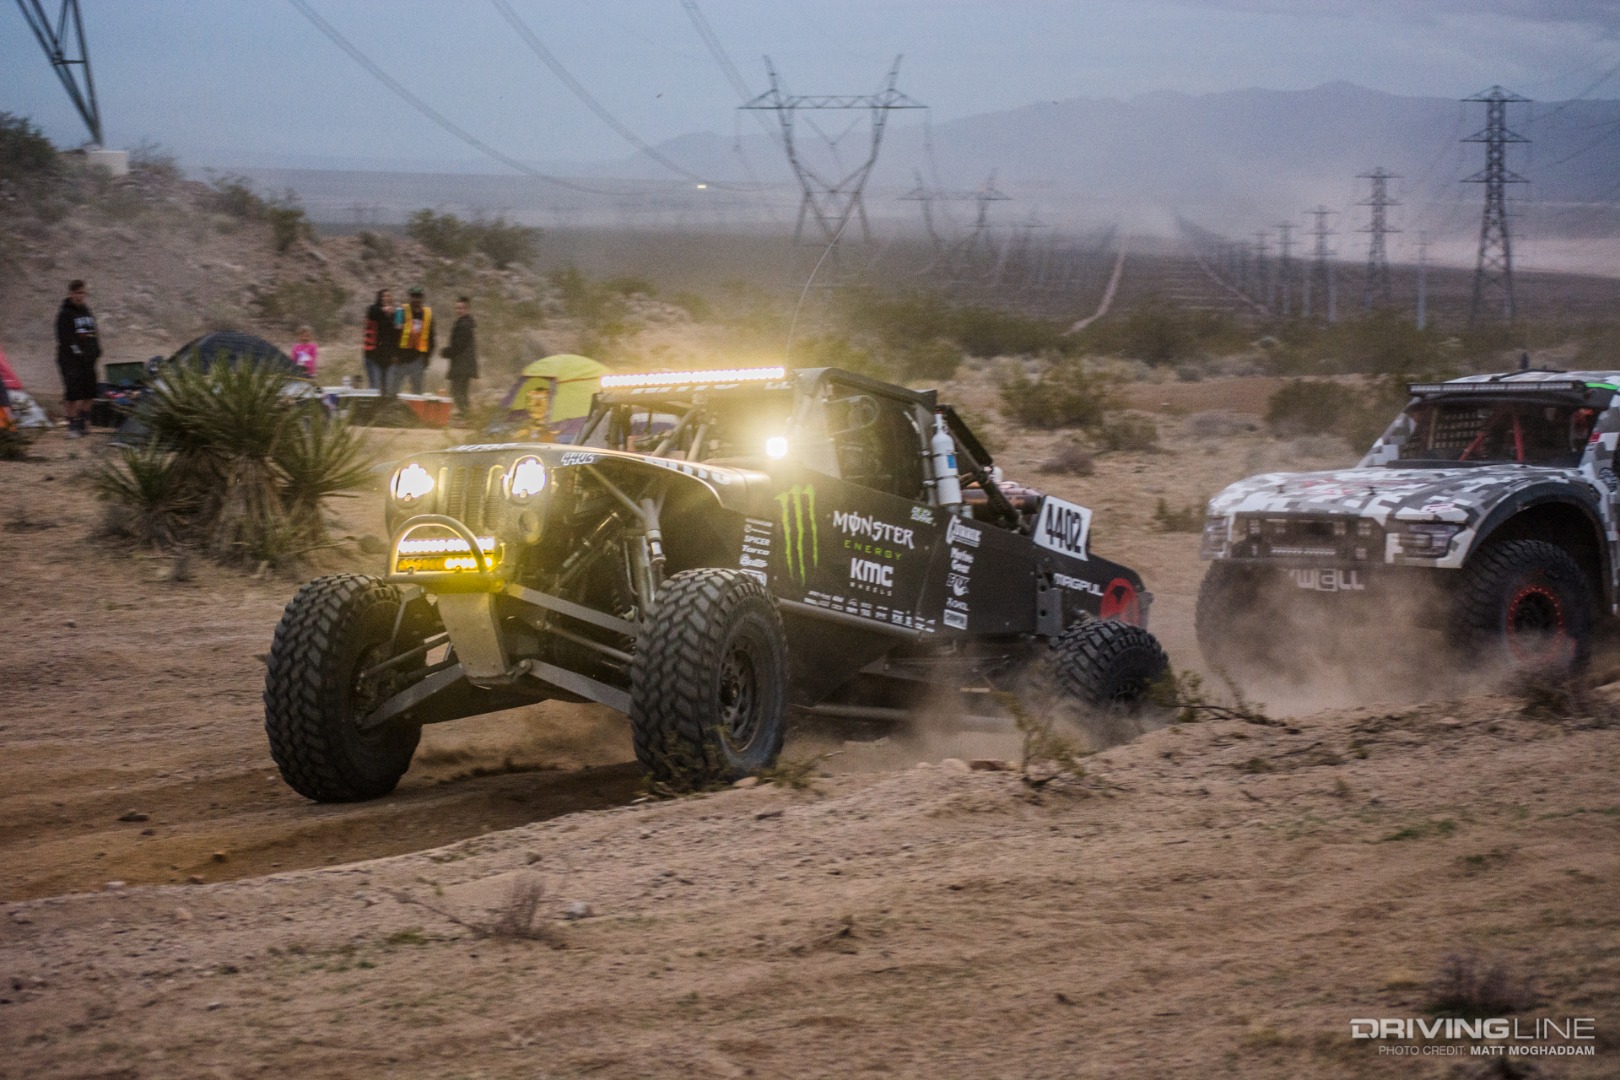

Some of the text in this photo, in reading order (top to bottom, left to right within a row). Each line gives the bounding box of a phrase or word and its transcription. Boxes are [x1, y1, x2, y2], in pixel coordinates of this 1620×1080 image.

[832, 510, 915, 550] MONSTER
[1046, 502, 1083, 554] 4402
[843, 539, 903, 561] ENERGY
[850, 557, 894, 588] KMC
[1053, 572, 1105, 597] MAGPUL
